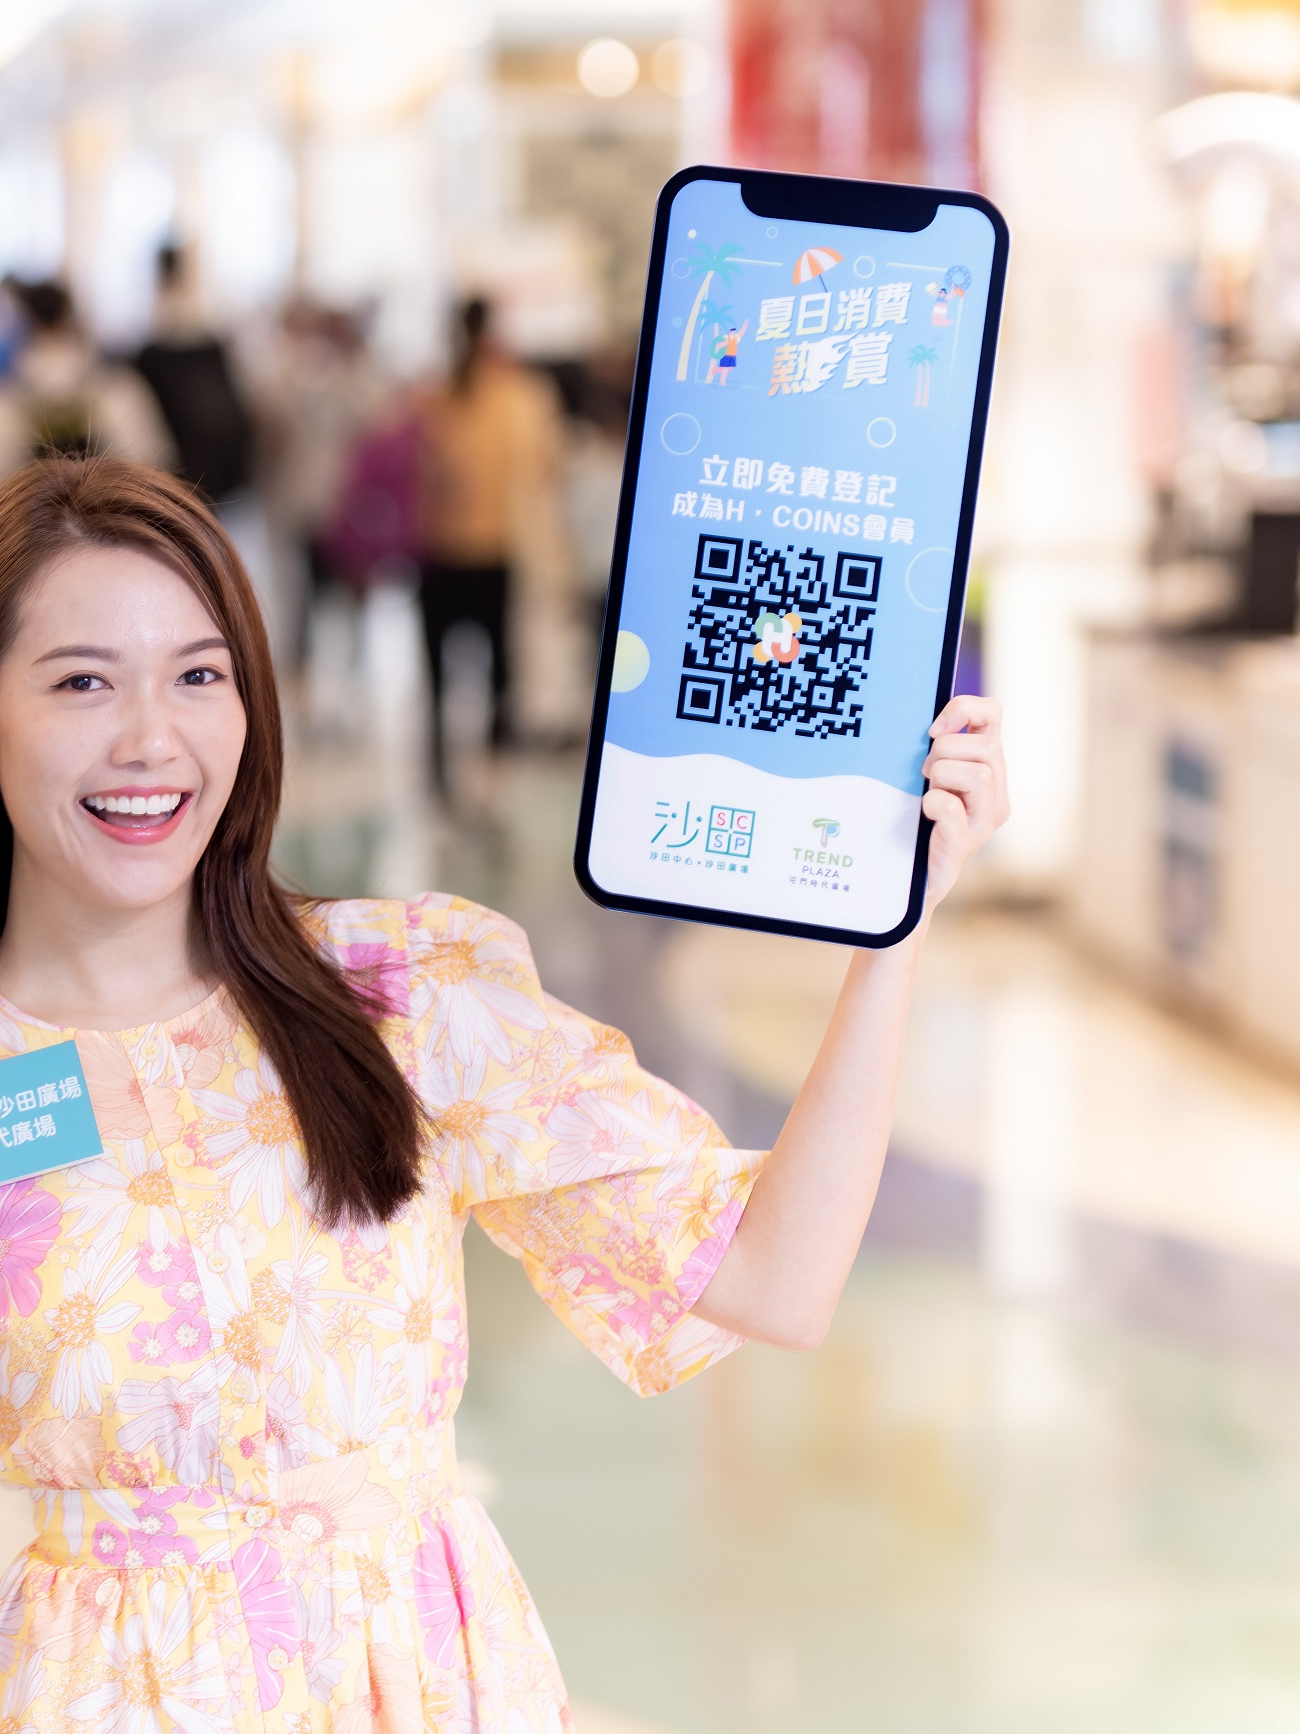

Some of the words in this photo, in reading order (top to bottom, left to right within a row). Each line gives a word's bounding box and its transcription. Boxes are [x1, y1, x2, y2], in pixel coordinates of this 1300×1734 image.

[755, 282, 913, 342] 夏日消費
[767, 331, 894, 397] 熱賞
[698, 453, 897, 508] 立即免費登記
[793, 847, 854, 868] TREND
[802, 865, 840, 879] PLAZA
